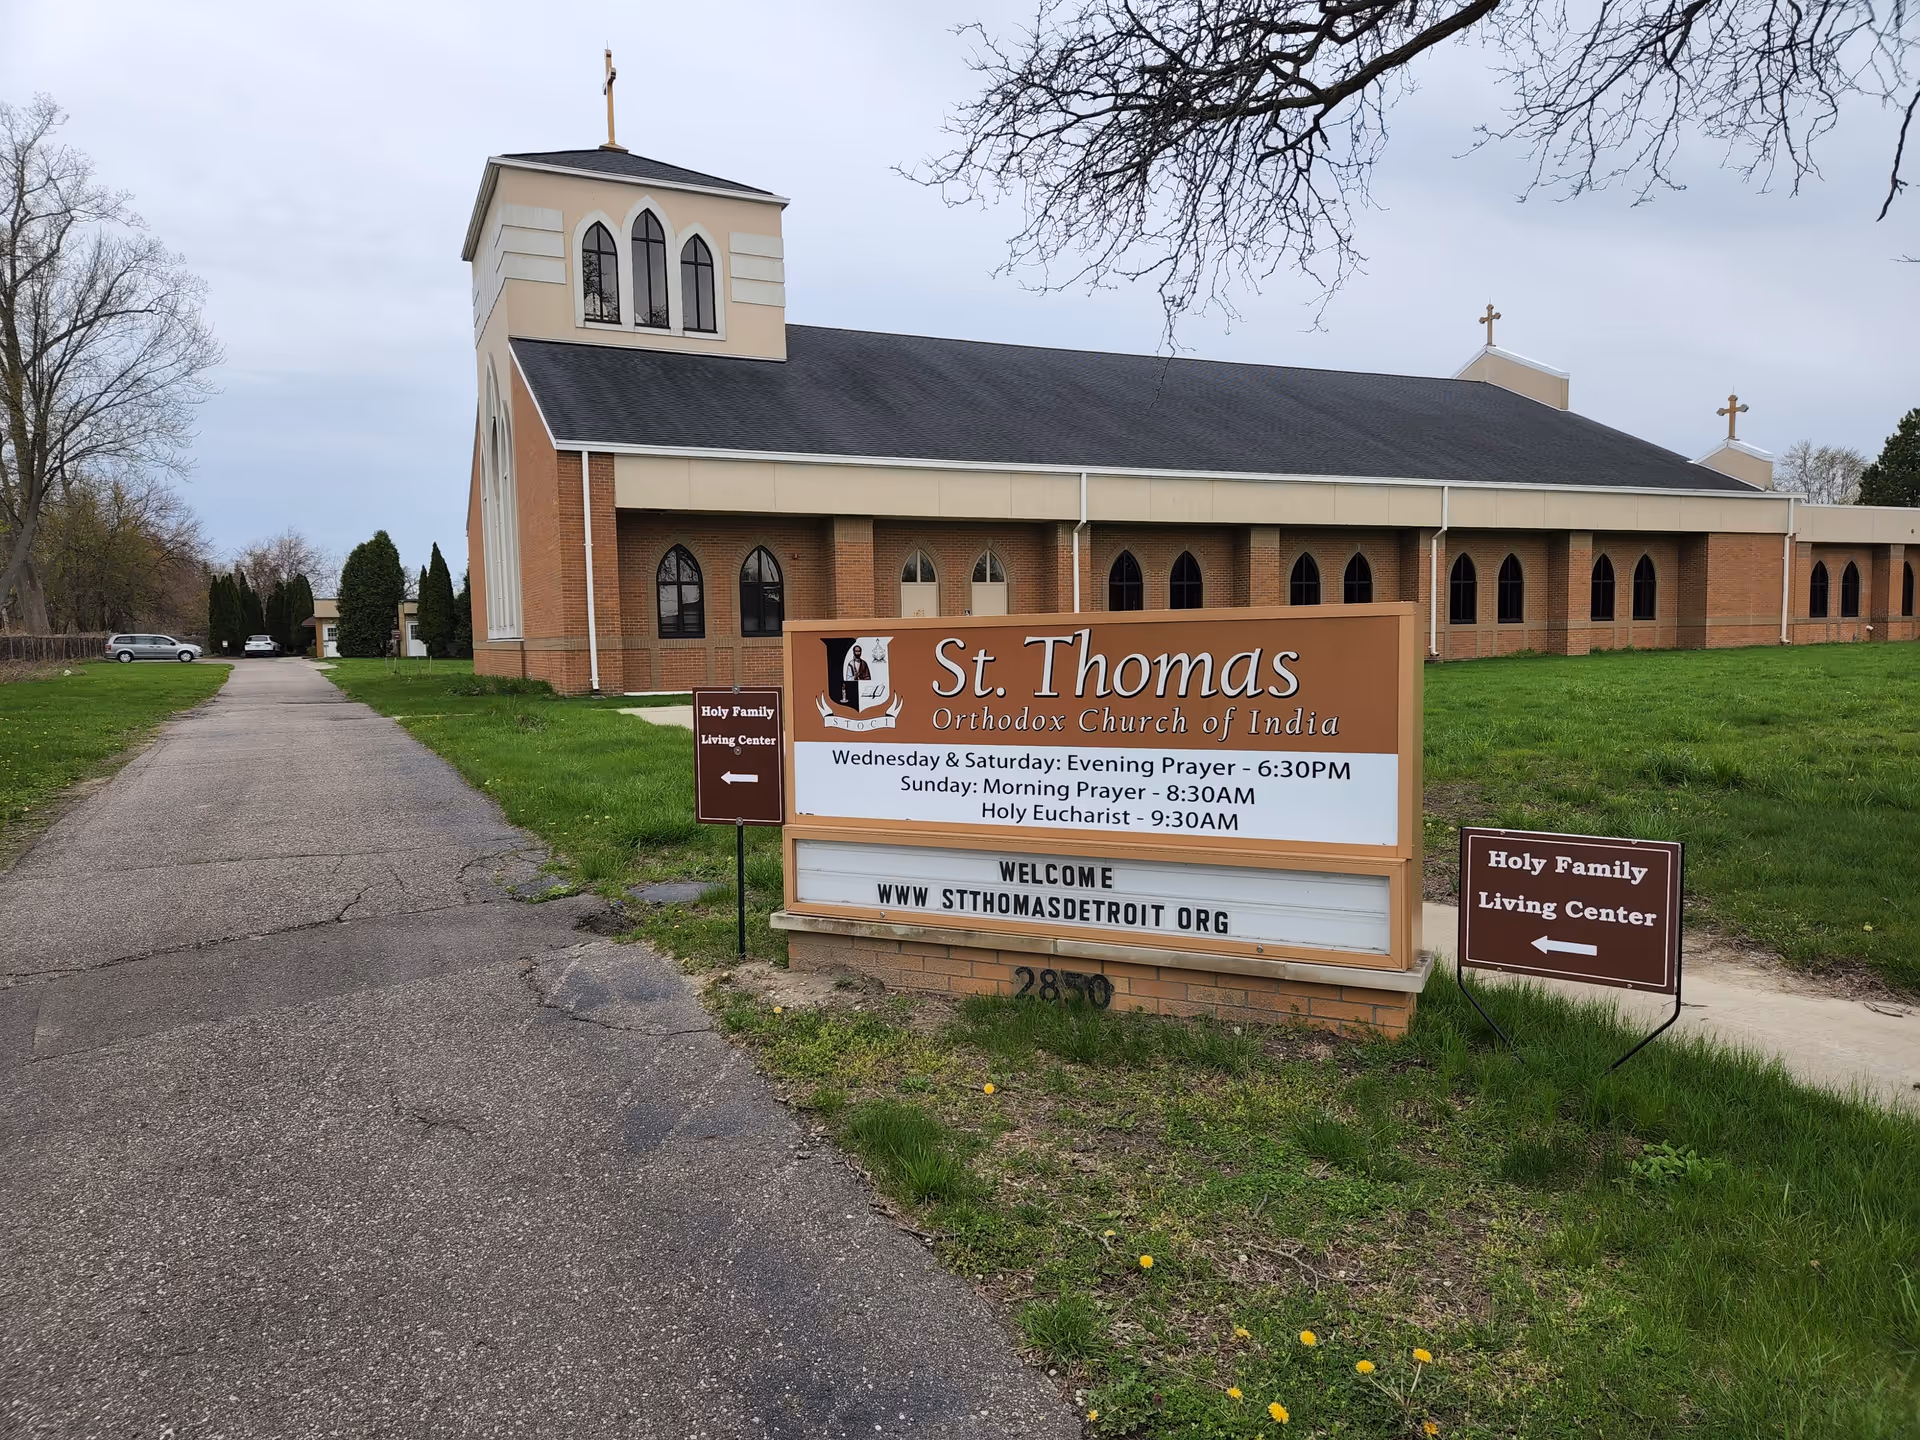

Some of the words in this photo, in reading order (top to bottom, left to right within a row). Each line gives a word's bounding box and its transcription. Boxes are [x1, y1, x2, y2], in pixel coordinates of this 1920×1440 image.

[932, 637, 1006, 698] St.
[1023, 627, 1300, 699] Thomas
[701, 706, 729, 719] Holy
[732, 706, 774, 719] Family
[833, 718, 888, 730] STOCI
[932, 705, 1066, 732] Orthodox
[1078, 706, 1187, 734] Church
[1202, 706, 1237, 742] of
[1248, 707, 1340, 736] India
[701, 734, 735, 747] Living
[738, 735, 776, 745] Center
[832, 750, 940, 771] Wednesday
[945, 752, 959, 768] &
[965, 752, 1061, 774] Saturday:
[1068, 754, 1154, 778] Evening
[1162, 757, 1236, 780] Prayer
[1257, 760, 1351, 780] 6:30PM
[901, 776, 977, 797] Sunday:
[983, 778, 1070, 801] Morning
[1077, 781, 1146, 803] Prayer
[1166, 784, 1255, 805] 8:30AM
[982, 802, 1027, 823] Holy
[1034, 804, 1131, 826] Eucharist
[1151, 809, 1239, 831] 9:30AM
[1000, 861, 1113, 889] WELCOME
[1488, 850, 1547, 876] Holy
[1555, 856, 1648, 885] Family
[877, 884, 928, 907] WWW
[942, 888, 1165, 927] STTHOMASDETROIT
[1177, 907, 1229, 934] ORG
[1478, 891, 1557, 920] Living
[1565, 901, 1657, 926] Center
